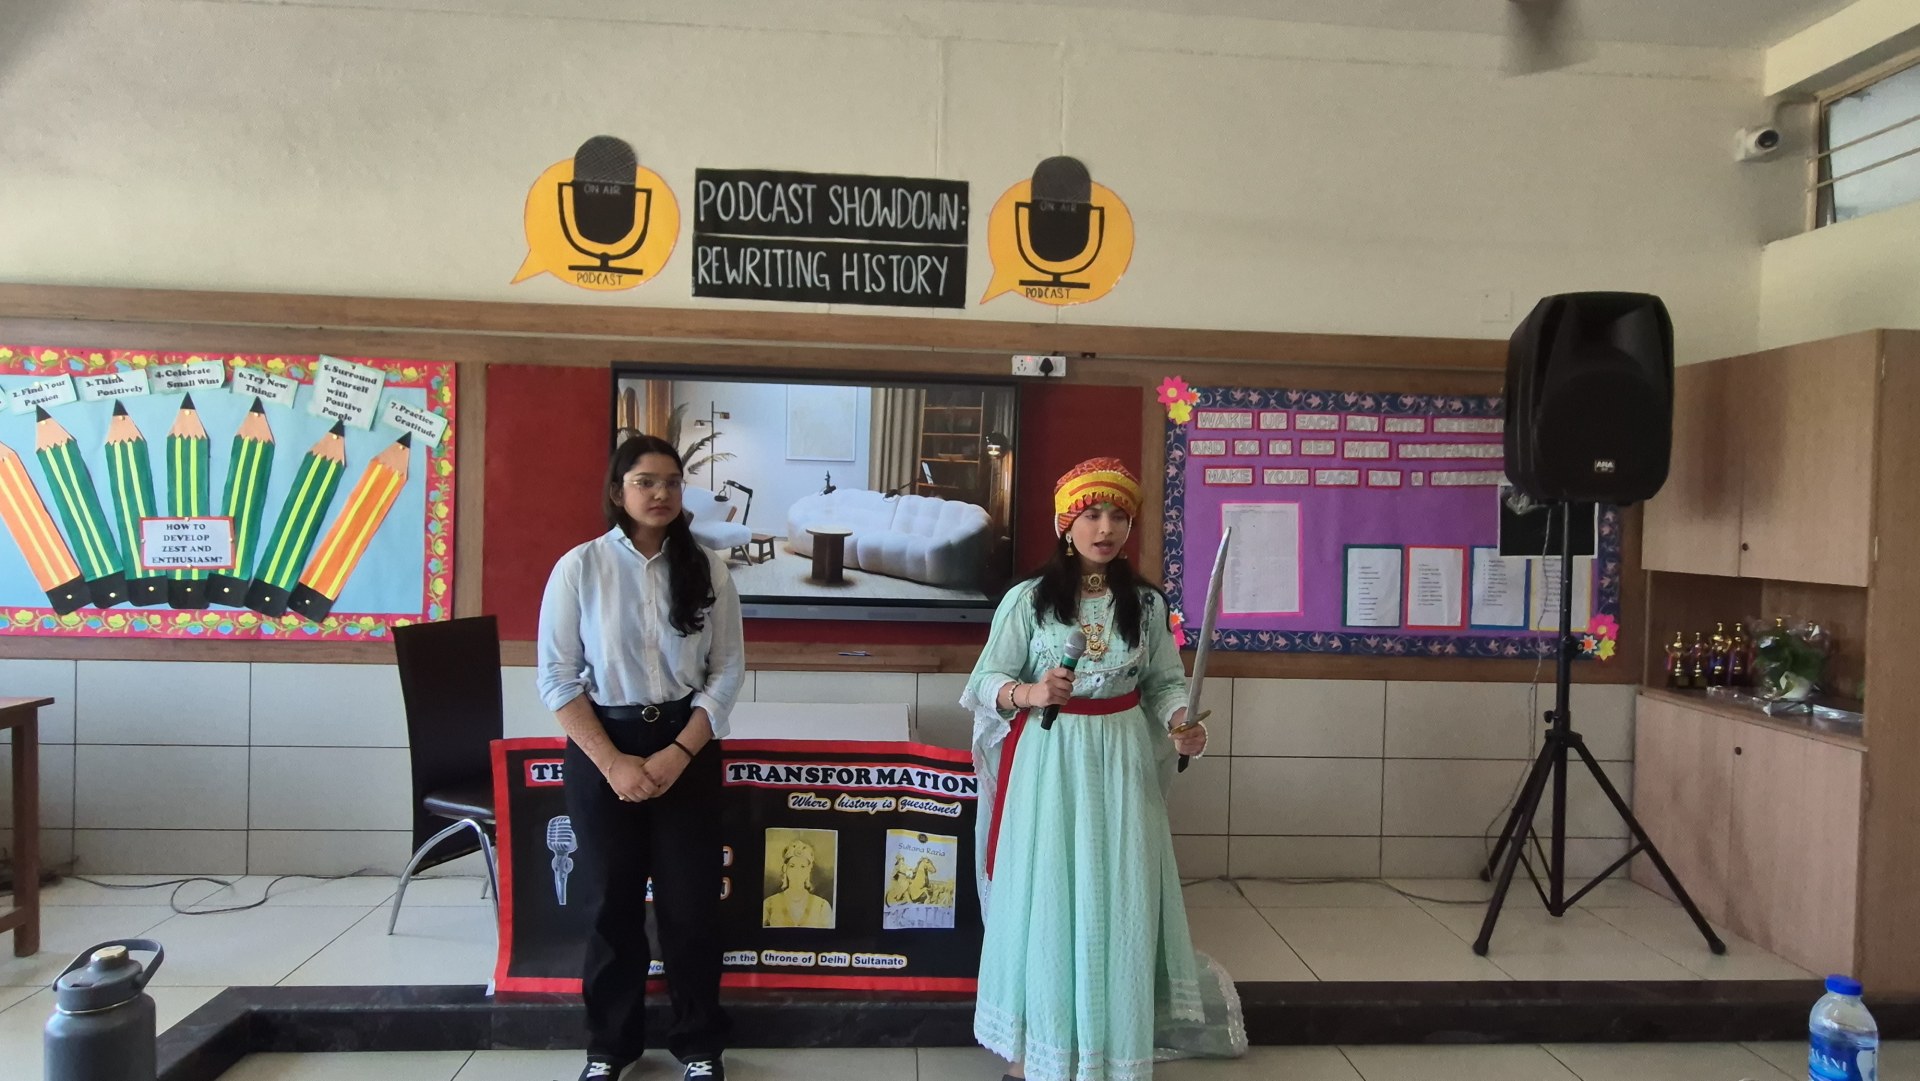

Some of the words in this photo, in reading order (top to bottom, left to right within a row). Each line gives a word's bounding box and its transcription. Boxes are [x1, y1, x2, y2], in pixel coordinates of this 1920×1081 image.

[583, 183, 599, 194] ON
[602, 184, 621, 195] AIR
[699, 180, 816, 225] PODCAST
[829, 184, 967, 231] SHOWDOWN:
[1040, 201, 1055, 212] ON
[698, 246, 830, 291] REWRITING
[842, 252, 948, 296] HISTORY
[576, 272, 623, 286] PODCAST
[1025, 287, 1071, 299] PODCAST
[165, 367, 211, 378] Celebrate
[331, 365, 378, 385] Surround
[94, 374, 125, 387] Think
[166, 380, 196, 389] Small
[197, 377, 220, 386] Wins
[247, 373, 265, 385] Try
[267, 378, 289, 390] New
[329, 376, 370, 394] Yourself
[21, 384, 44, 396] Find
[97, 385, 143, 397] Positively
[245, 384, 277, 398] Things
[326, 386, 349, 399] with
[24, 393, 59, 407] Passion
[325, 396, 362, 414] Positive
[321, 406, 353, 422] People
[399, 404, 435, 426] Practice
[394, 414, 437, 439] Gratitude
[163, 534, 210, 542] DEVELOP
[152, 556, 223, 564] ENTHUSIASM?
[532, 763, 564, 780] TH
[728, 763, 978, 795] TRANSFORMATION
[791, 795, 828, 809] Where
[837, 795, 877, 811] history
[882, 798, 893, 809] is
[900, 798, 959, 815] questioned
[898, 843, 925, 853] Sultana
[926, 847, 946, 857] Razia
[739, 954, 756, 962] the
[764, 953, 798, 963] throne
[801, 955, 813, 964] of
[820, 955, 847, 964] Delhi
[854, 956, 904, 966] Sultanate
